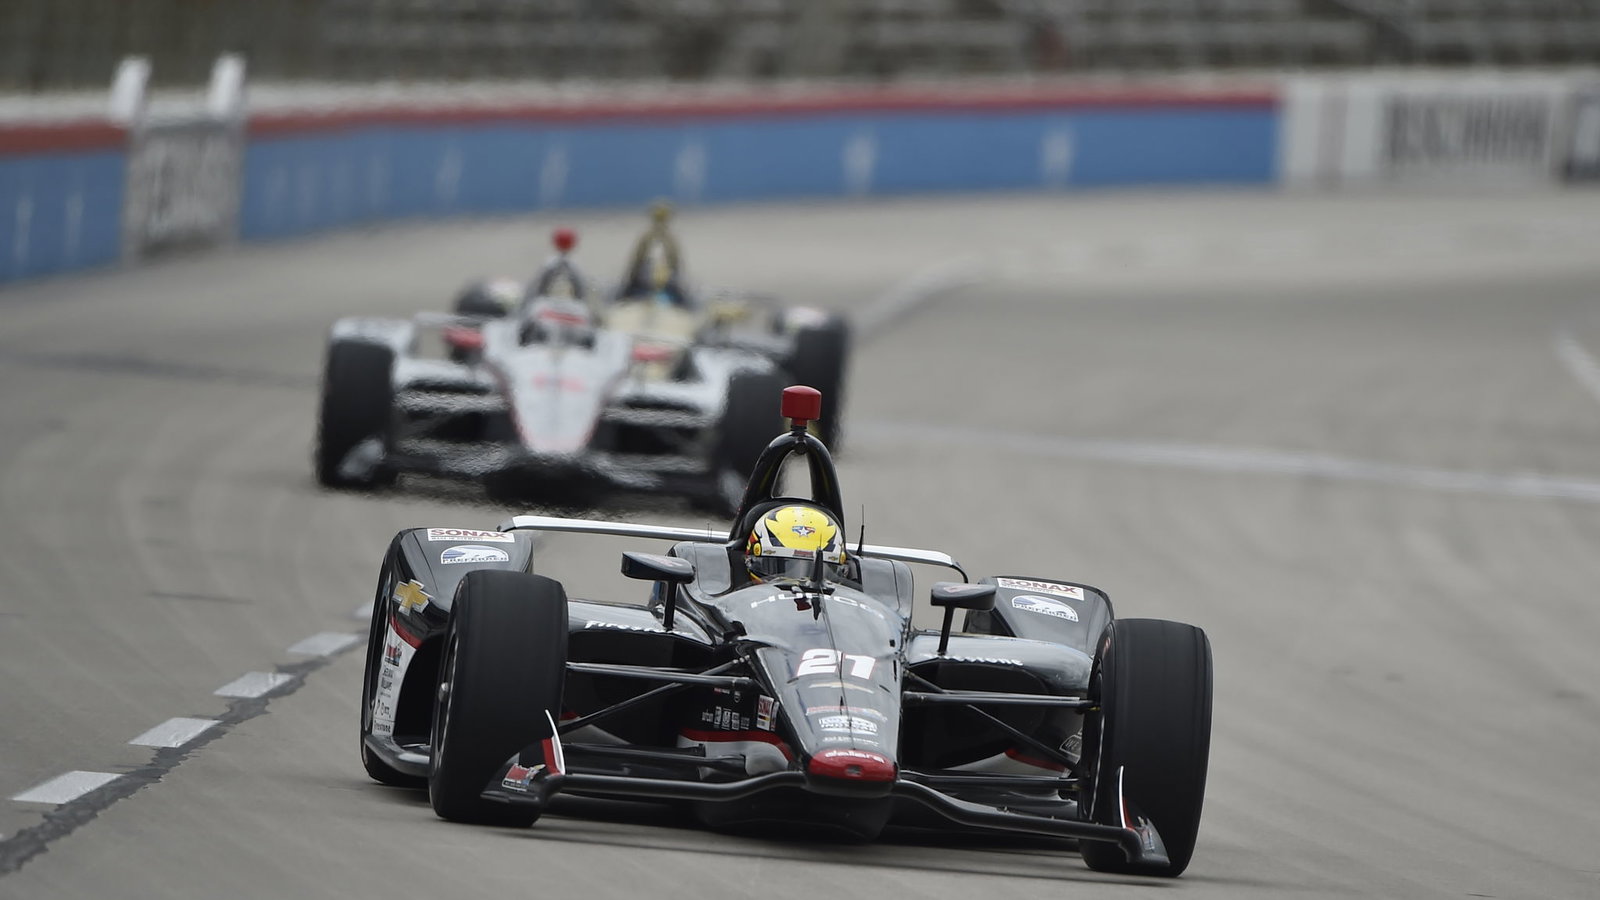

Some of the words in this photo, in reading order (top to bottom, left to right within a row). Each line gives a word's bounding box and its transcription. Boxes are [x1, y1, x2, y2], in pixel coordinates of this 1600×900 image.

[430, 528, 508, 539] SONAX
[1001, 579, 1077, 594] SONAX
[796, 647, 877, 681] 21
